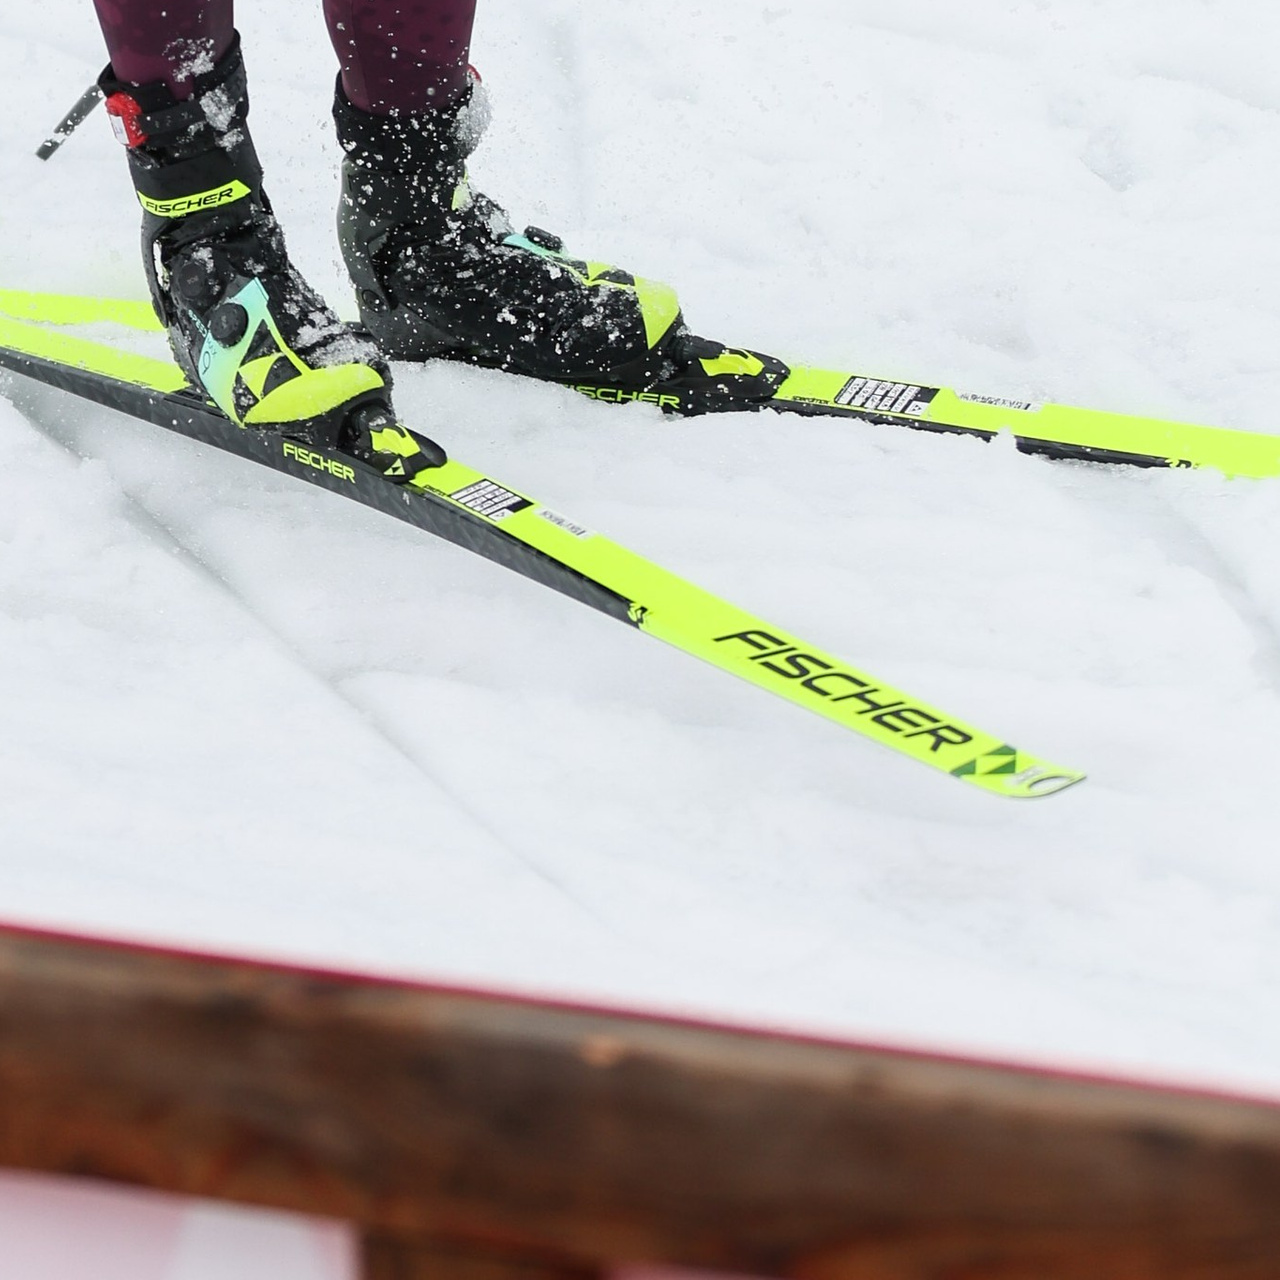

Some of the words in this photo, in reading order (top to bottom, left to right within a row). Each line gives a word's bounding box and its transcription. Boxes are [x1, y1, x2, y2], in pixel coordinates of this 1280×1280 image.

[145, 187, 233, 213] FISCHER
[563, 384, 681, 409] SCHER
[283, 442, 356, 484] FISCHER
[712, 630, 974, 752] FISCHER
